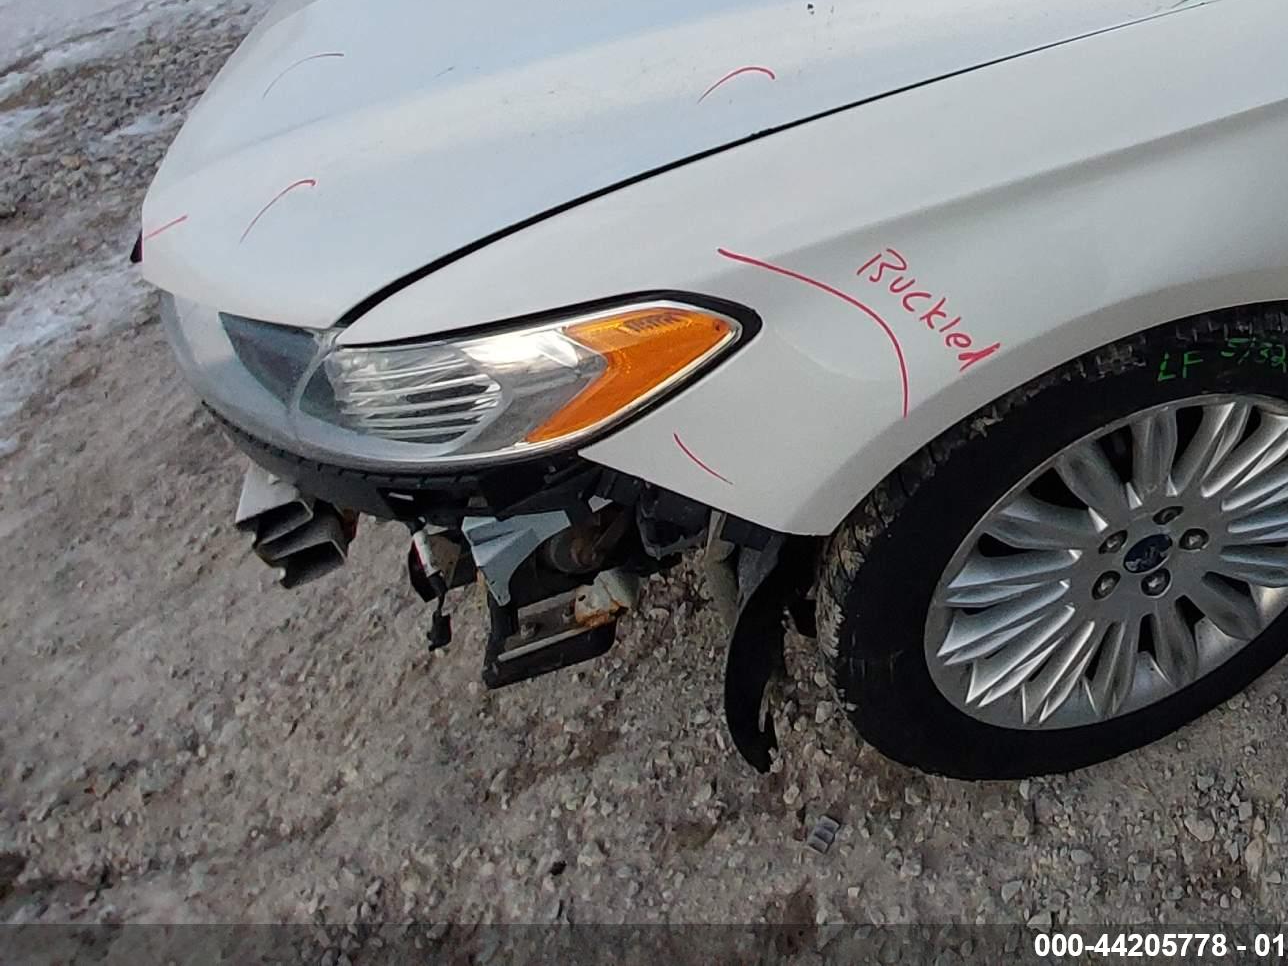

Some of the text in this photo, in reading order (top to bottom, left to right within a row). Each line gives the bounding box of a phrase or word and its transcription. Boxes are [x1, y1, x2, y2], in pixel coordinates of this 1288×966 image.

[856, 247, 1001, 372] Buckled
[1157, 337, 1288, 381] LF 5/32
